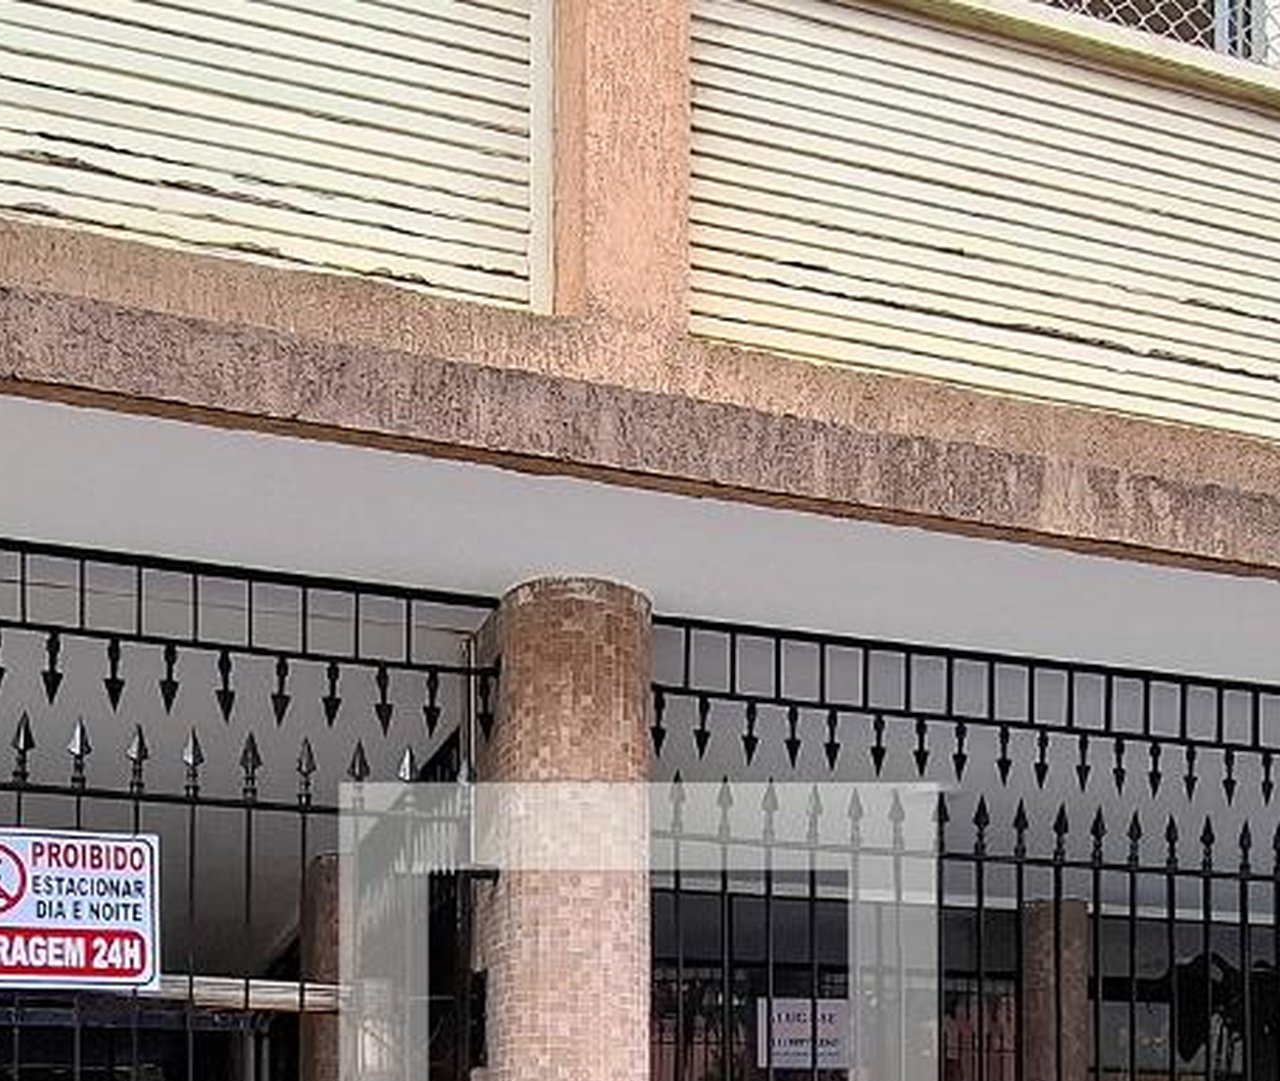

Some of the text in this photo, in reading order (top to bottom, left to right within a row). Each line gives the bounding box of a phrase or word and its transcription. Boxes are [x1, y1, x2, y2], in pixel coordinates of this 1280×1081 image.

[31, 842, 144, 871] PROIBIDO
[32, 875, 145, 898] ESTACIONAR
[36, 901, 142, 922] DIA E NOITE
[92, 938, 141, 969] 24H
